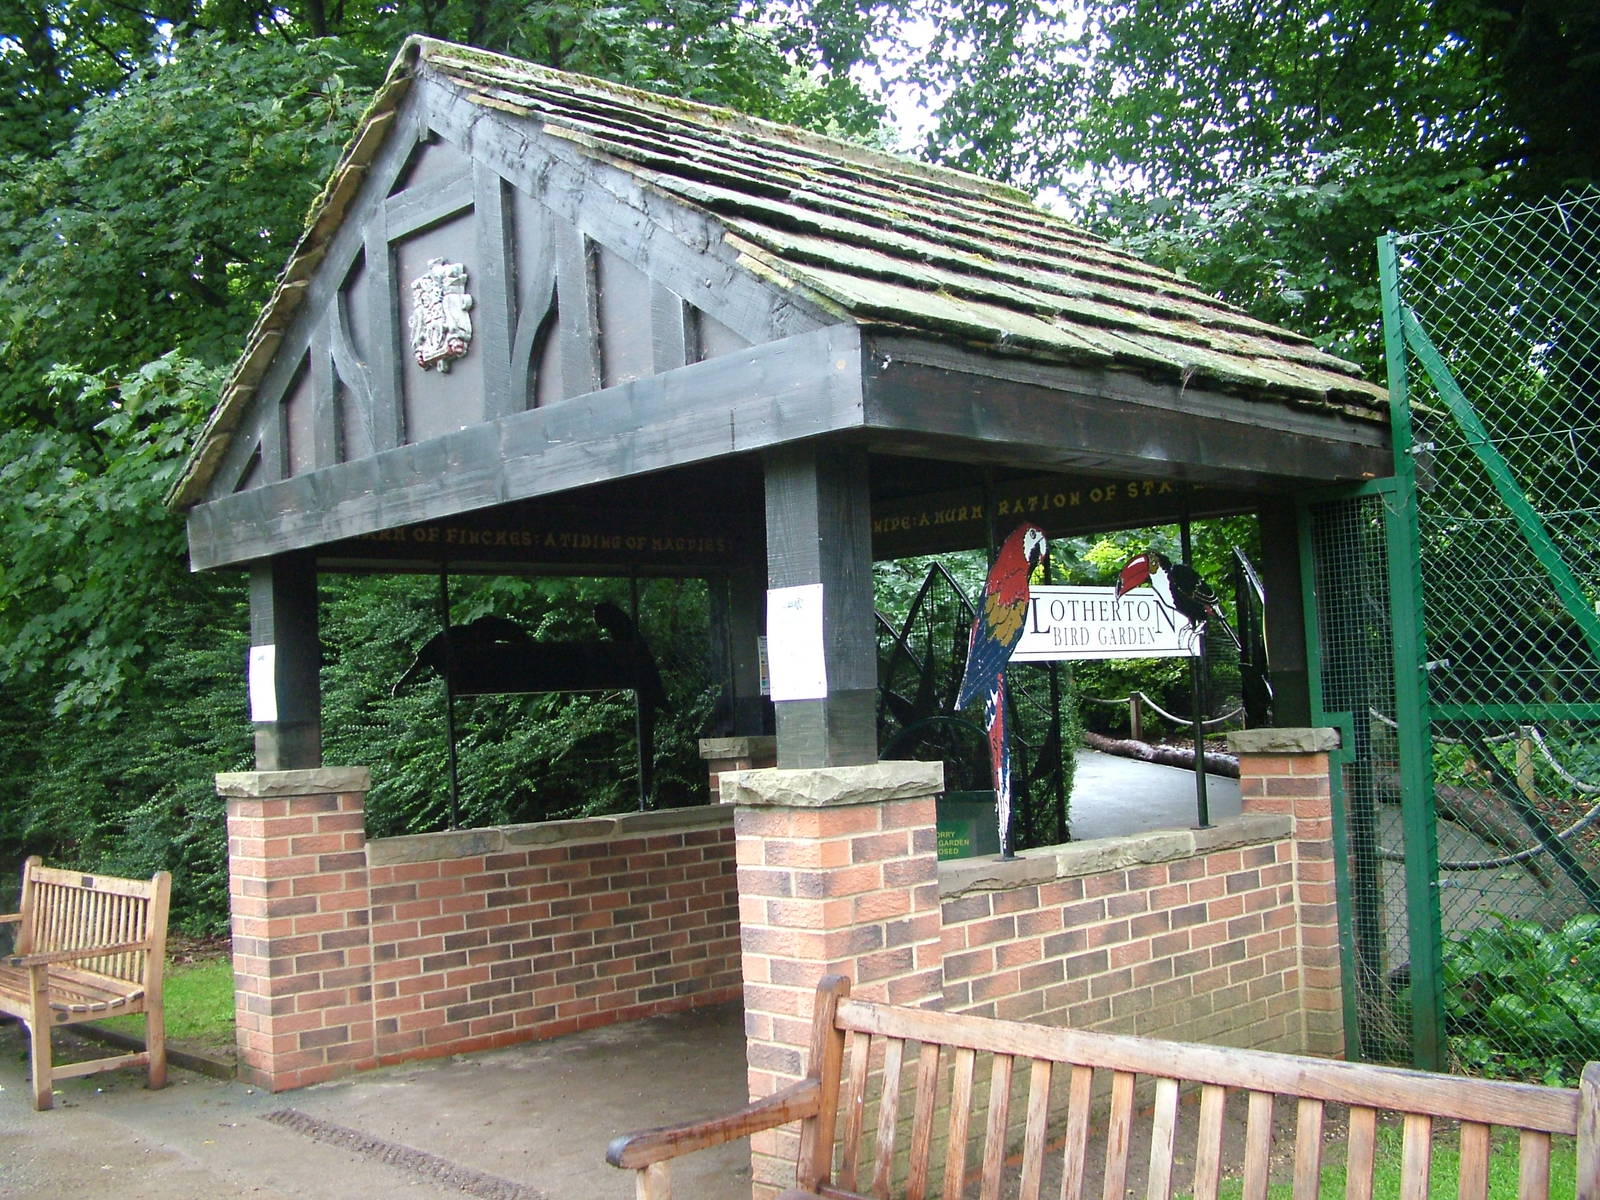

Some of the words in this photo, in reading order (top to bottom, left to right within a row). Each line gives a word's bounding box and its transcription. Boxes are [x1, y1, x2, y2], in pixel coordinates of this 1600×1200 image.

[919, 512, 930, 526] A
[1089, 484, 1117, 503] OF
[413, 527, 440, 542] OF
[624, 536, 648, 551] OF
[1030, 597, 1176, 634] LOTHERTON
[1053, 627, 1090, 646] BIRD
[1098, 626, 1156, 646] GARDEN
[937, 831, 955, 839] ORRY
[938, 839, 970, 847] GARDEN
